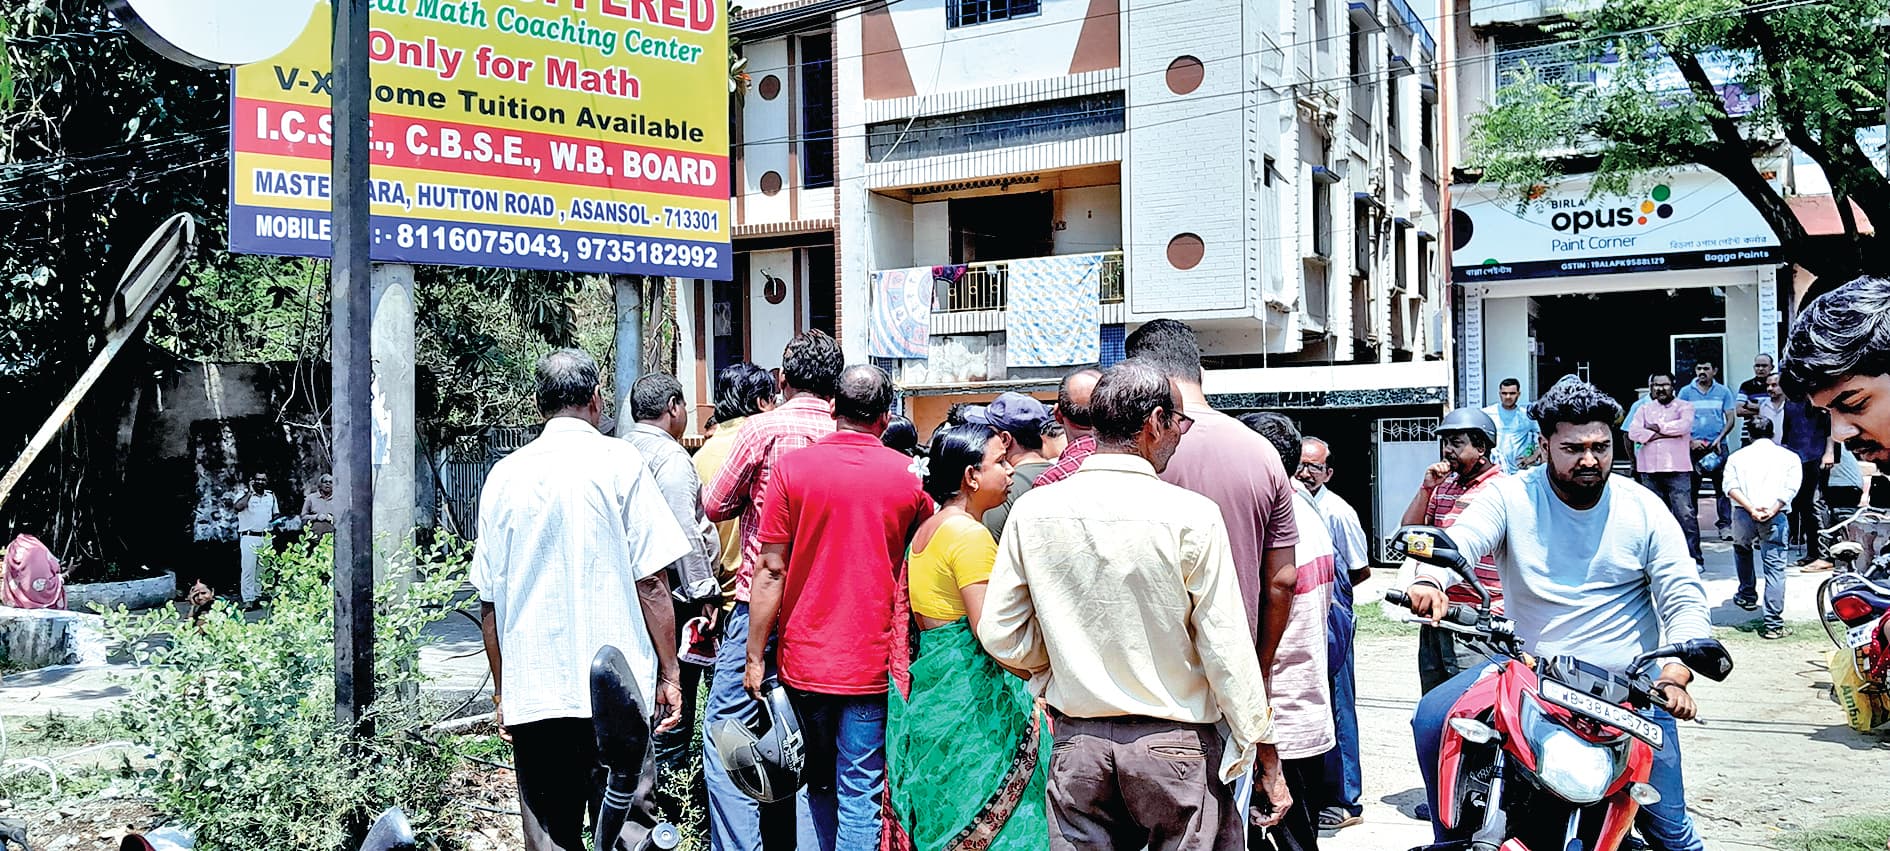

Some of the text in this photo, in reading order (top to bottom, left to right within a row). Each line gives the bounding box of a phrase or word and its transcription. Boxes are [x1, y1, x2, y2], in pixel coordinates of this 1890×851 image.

[416, 0, 487, 27] Math
[497, 7, 616, 54] Coaching
[625, 29, 702, 63] Center
[369, 30, 640, 98] Only for Math
[369, 77, 447, 109] ome
[457, 89, 565, 124] Tuition
[576, 107, 704, 143] Available
[405, 124, 541, 174] C.B.S.E.,
[550, 140, 613, 176] W.B.
[623, 149, 717, 187] BOARD
[418, 185, 498, 212] HUTTON
[505, 193, 554, 217] ROAD
[571, 199, 650, 226] ASANSOL
[664, 207, 718, 232] 713301
[1551, 199, 1585, 209] BIRLA
[1551, 207, 1634, 235] opus
[256, 215, 331, 240] MOBILE
[397, 223, 569, 264] 8116075043,
[577, 237, 718, 269] 9735182992
[1552, 236, 1637, 252] Paint Corner
[1704, 250, 1769, 262] Bagga Paints
